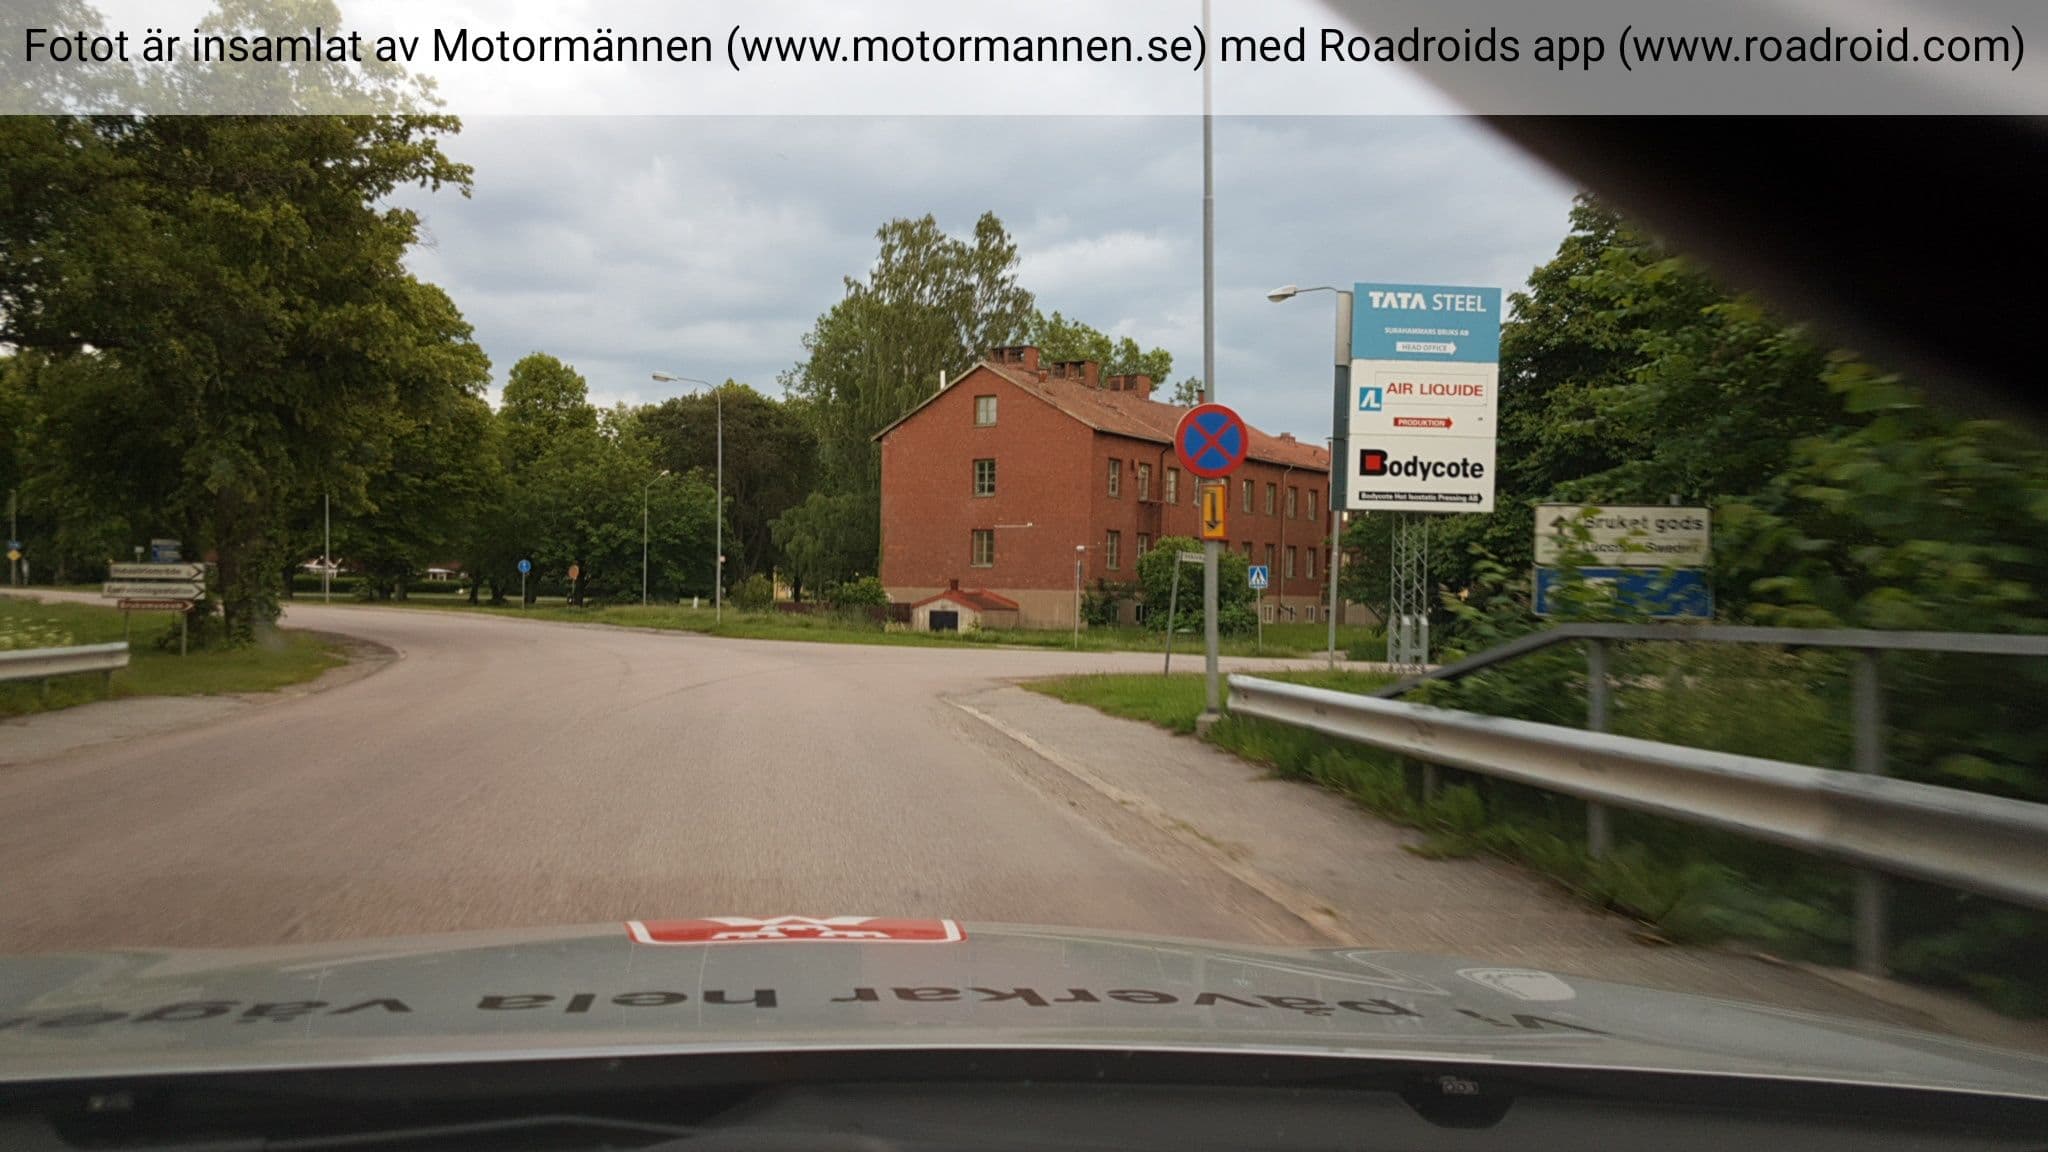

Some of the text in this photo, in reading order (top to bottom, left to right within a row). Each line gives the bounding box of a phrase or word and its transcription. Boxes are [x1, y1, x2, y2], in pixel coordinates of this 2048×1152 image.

[1369, 291, 1487, 313] TATA STEEL
[1401, 343, 1448, 352] HEAD OFFICE
[1386, 382, 1484, 397] AIR LIQUIDE
[1398, 418, 1446, 427] PRODUKTION
[1359, 448, 1485, 482] Bodycote
[1654, 514, 1705, 534] gods
[477, 989, 777, 1013] hela
[832, 987, 1424, 1018] påverkar
